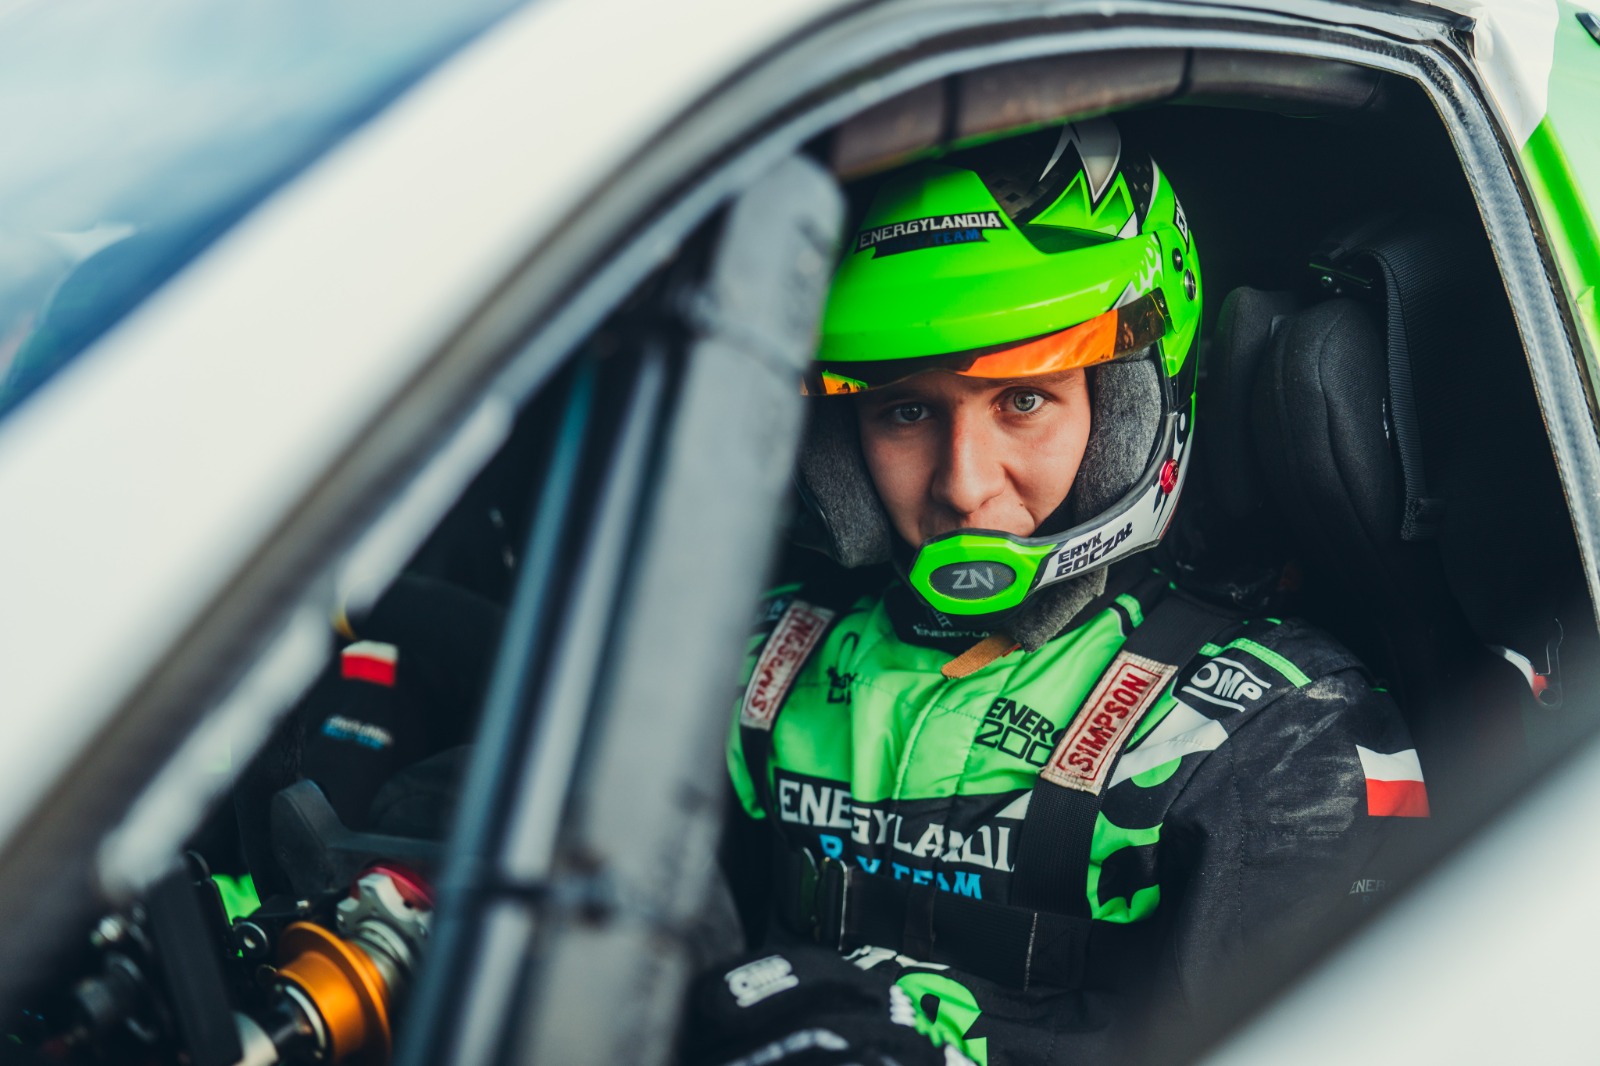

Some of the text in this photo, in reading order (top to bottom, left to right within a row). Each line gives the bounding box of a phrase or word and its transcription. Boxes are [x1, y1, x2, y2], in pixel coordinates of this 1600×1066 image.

[858, 212, 1002, 249] ENERGYLANDIA
[1057, 532, 1102, 565] ERYK
[951, 567, 995, 590] ZN
[1188, 659, 1264, 703] OMP
[1067, 672, 1151, 773] SIMPSON
